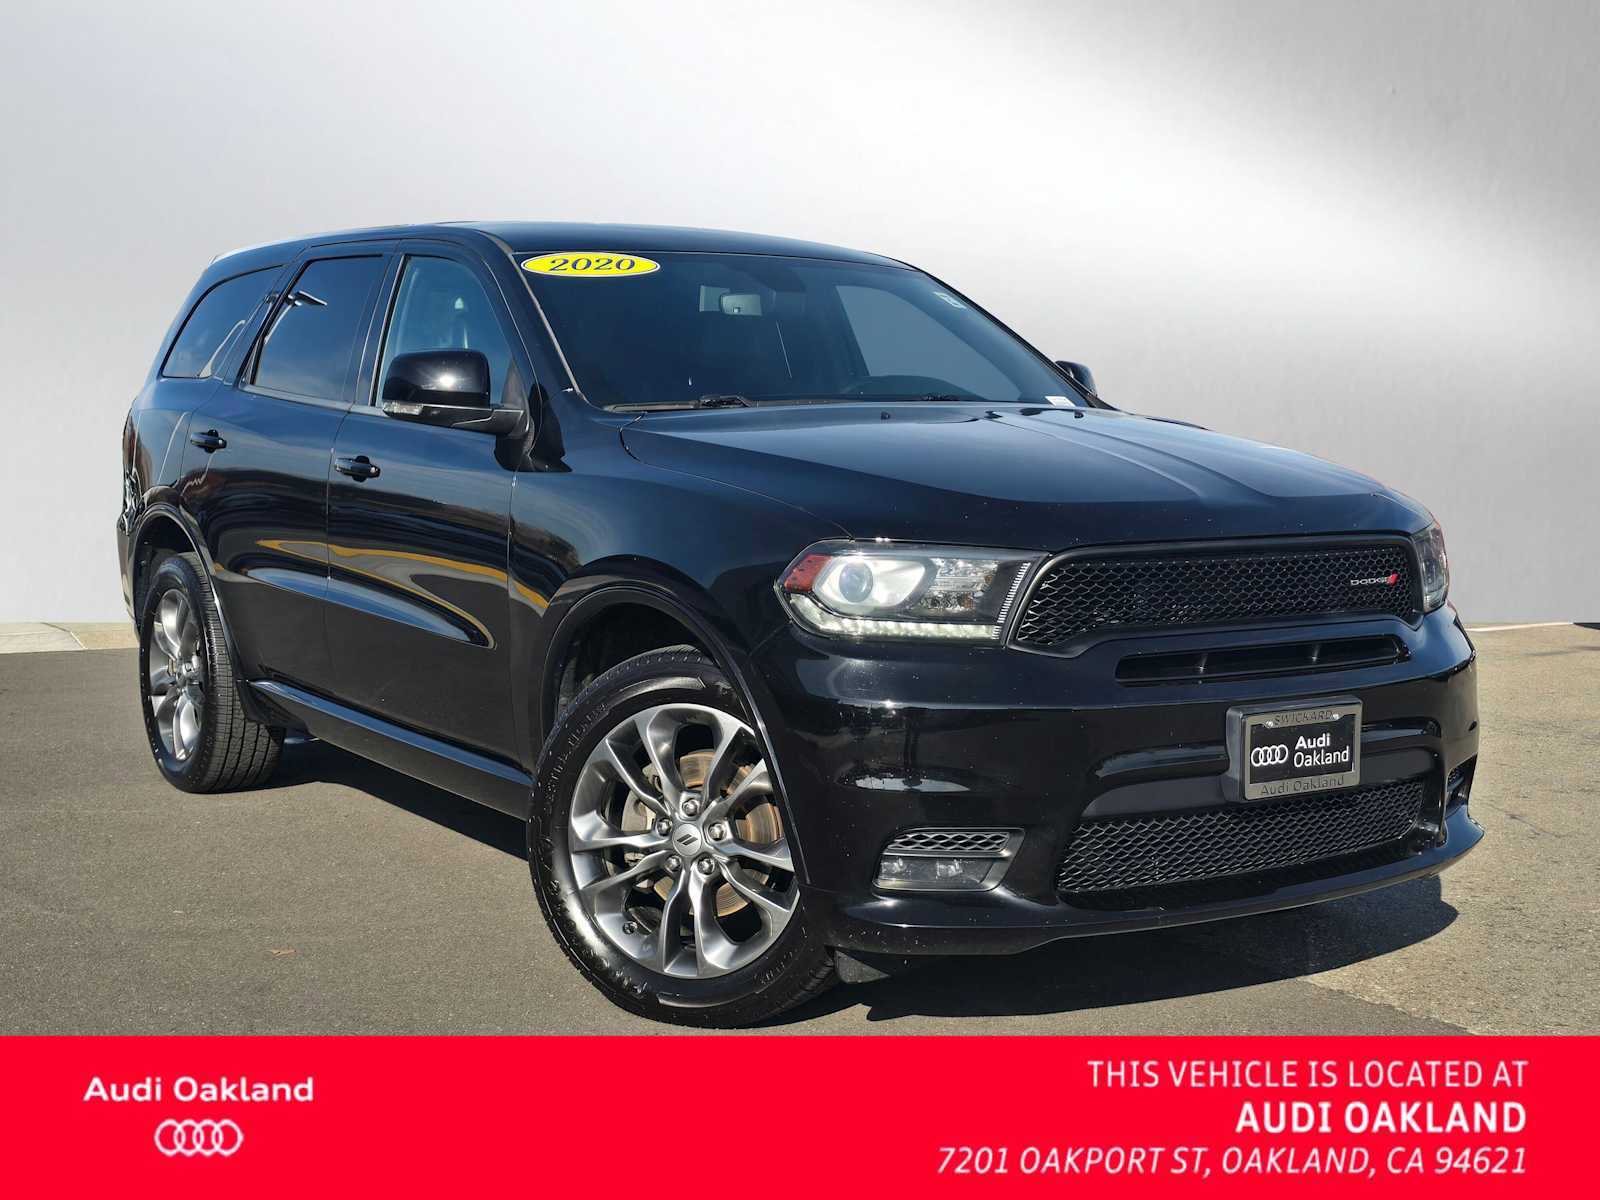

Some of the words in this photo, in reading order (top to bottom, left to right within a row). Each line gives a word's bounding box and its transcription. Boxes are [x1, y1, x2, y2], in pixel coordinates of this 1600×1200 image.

[549, 258, 635, 271] 2020
[1350, 577, 1391, 586] DODGE
[1274, 710, 1333, 726] SWICKARD
[1295, 733, 1331, 750] Audi
[1294, 746, 1350, 767] Oakland
[1260, 782, 1289, 795] Audi
[1293, 775, 1344, 791] Oakland
